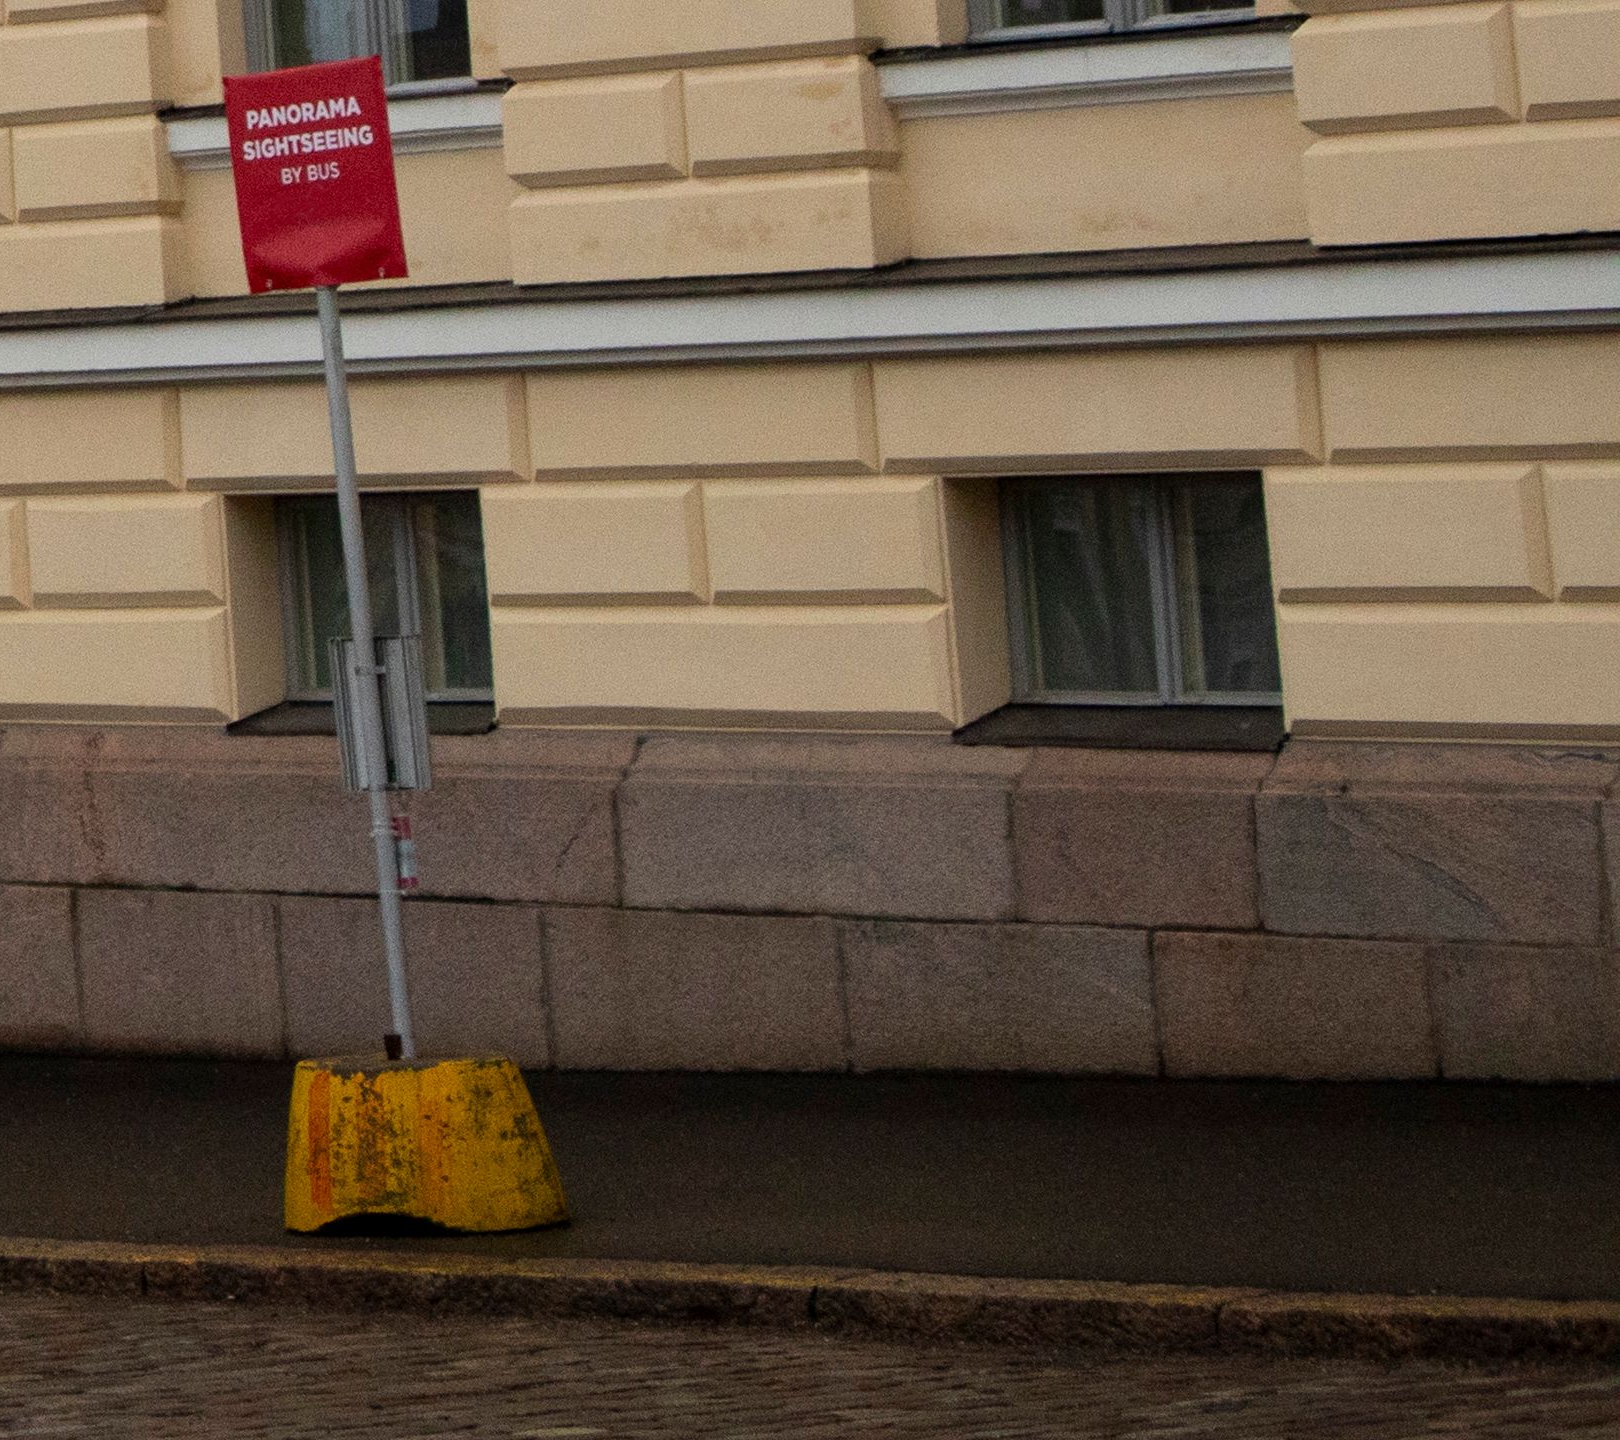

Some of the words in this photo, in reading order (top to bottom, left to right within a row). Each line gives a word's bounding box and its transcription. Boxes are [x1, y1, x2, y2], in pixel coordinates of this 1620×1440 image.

[246, 96, 361, 130] PANORAMA
[243, 125, 374, 161] SIGHTSEEING
[281, 166, 302, 185] BY
[307, 162, 340, 181] BUS
